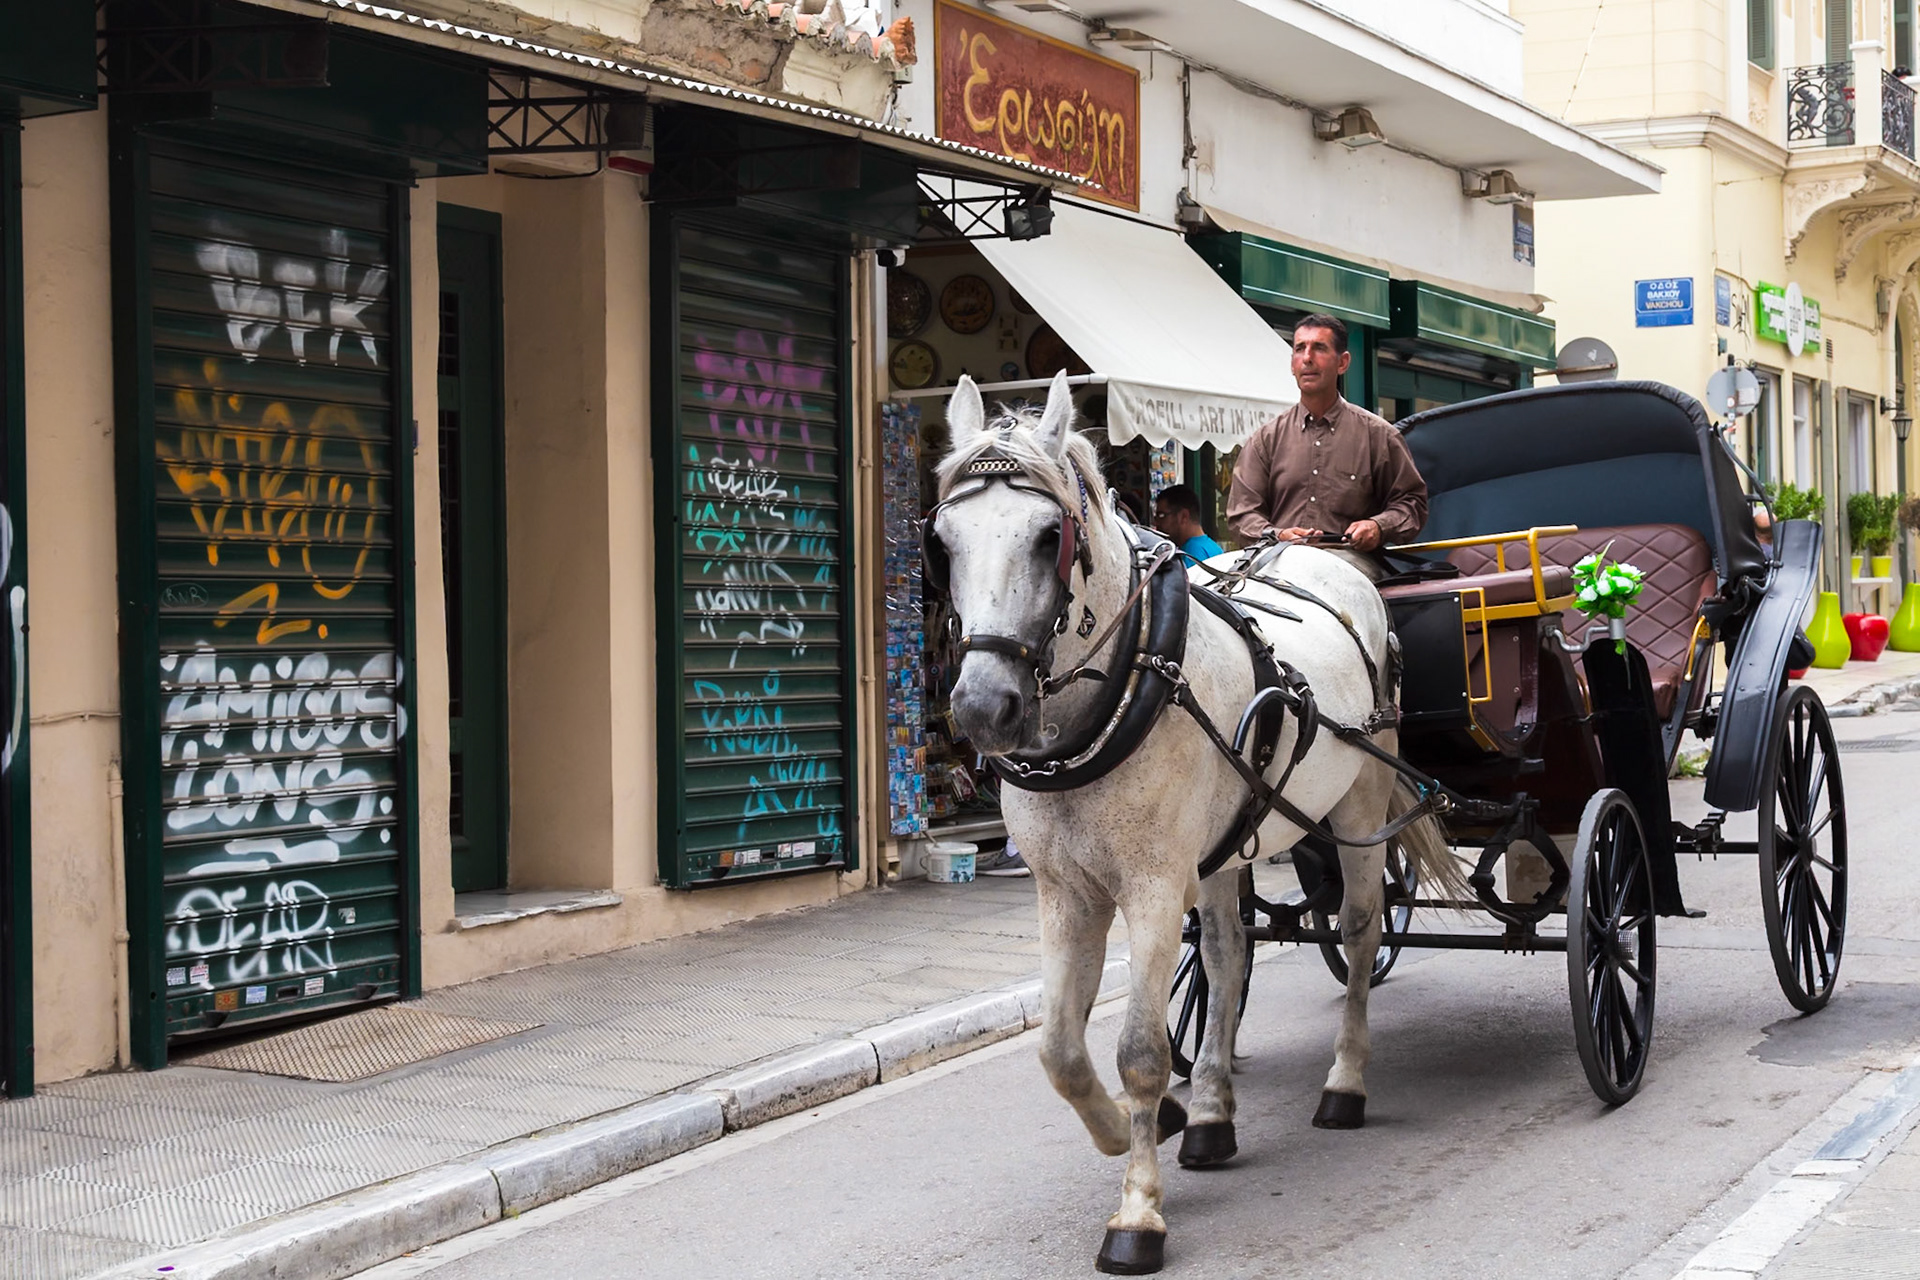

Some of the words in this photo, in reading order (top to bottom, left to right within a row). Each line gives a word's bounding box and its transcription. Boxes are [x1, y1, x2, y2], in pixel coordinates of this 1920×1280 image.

[1649, 281, 1679, 290] ΟΔΟΣ
[1645, 300, 1684, 309] VAKCHOU
[1198, 405, 1225, 434] ART
[1230, 408, 1246, 435] IN
